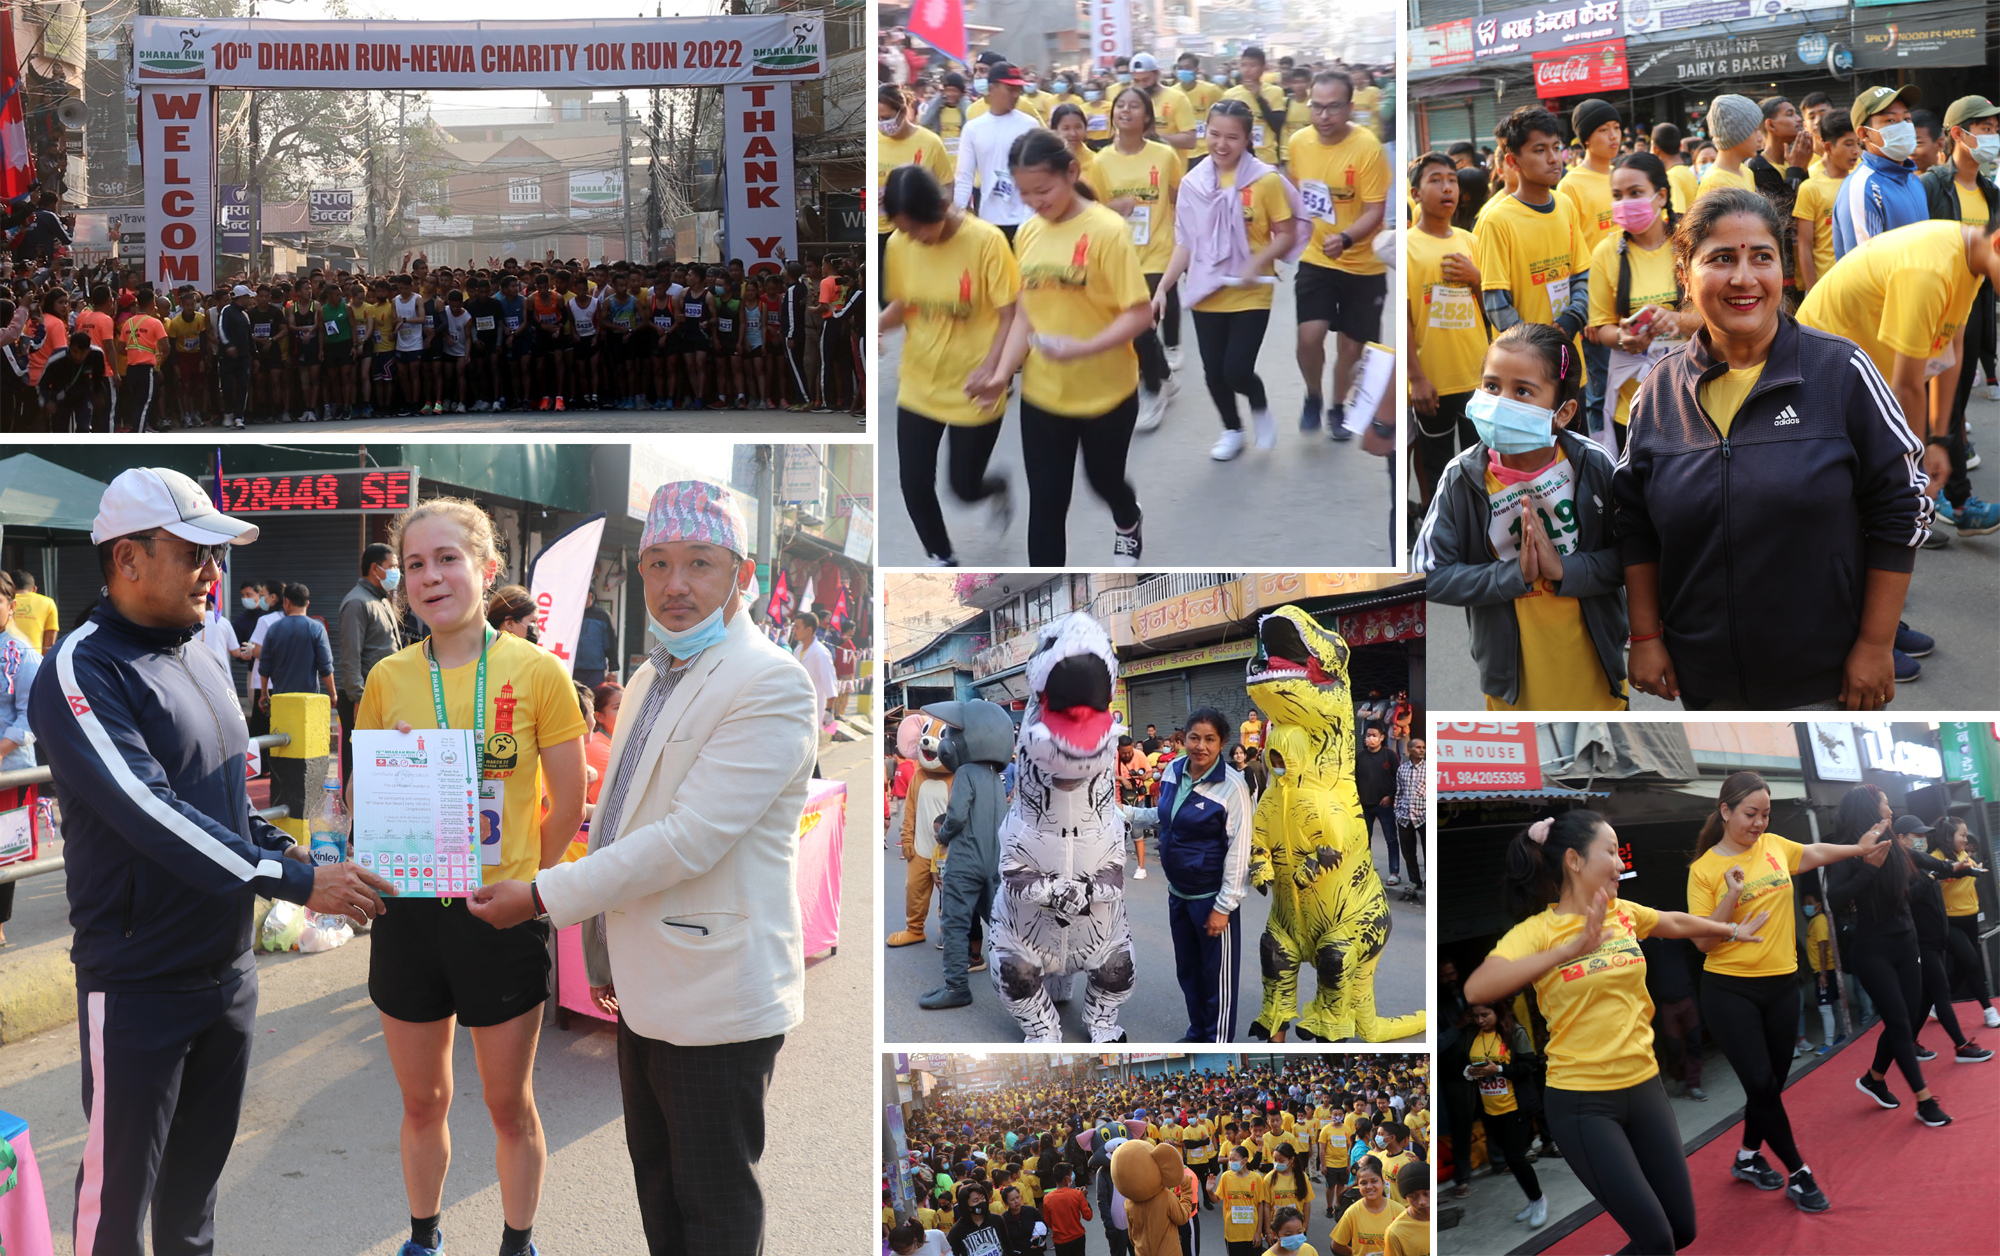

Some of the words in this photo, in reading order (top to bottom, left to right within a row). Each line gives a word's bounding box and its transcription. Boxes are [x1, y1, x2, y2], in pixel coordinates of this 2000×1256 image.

[1864, 33, 1889, 44] SPICY
[1943, 28, 1976, 39] HOUSE
[139, 50, 179, 59] DHARAN
[185, 50, 204, 59] RUN
[258, 43, 347, 71] DHARAN
[355, 43, 476, 73] RUN-NEWA
[481, 43, 578, 73] CHARITY
[584, 42, 627, 71] 10K
[631, 42, 677, 70] RUN
[684, 40, 743, 69] 2022
[753, 47, 793, 56] DHARAN
[798, 44, 818, 54] RUN
[1677, 63, 1715, 79] DAIRY
[1717, 60, 1729, 74] &
[1732, 54, 1788, 73] BAKERY
[742, 85, 781, 209] THANK
[152, 93, 202, 290] WELCOM
[606, 184, 622, 192] RUN
[310, 191, 351, 205] धरान
[109, 214, 122, 223] nal
[124, 214, 146, 223] Trave
[310, 207, 351, 222] डेन्टल
[745, 236, 782, 276] YO
[1630, 293, 1661, 302] HARAN
[1431, 300, 1474, 321] 2526
[1774, 418, 1800, 427] adidas
[361, 472, 410, 509] SE
[536, 592, 553, 633] AID
[1171, 651, 1205, 664] डेन्टल
[432, 673, 441, 703] DHARAN
[436, 704, 444, 720] RUN
[1464, 746, 1516, 759] HOUSE
[476, 746, 484, 781] DHARAN
[483, 769, 514, 779] RADI
[1456, 771, 1526, 785] 9842055395
[314, 850, 339, 863] kinley
[1232, 1211, 1254, 1220] 2523
[963, 1226, 1002, 1254] NIRVANA
